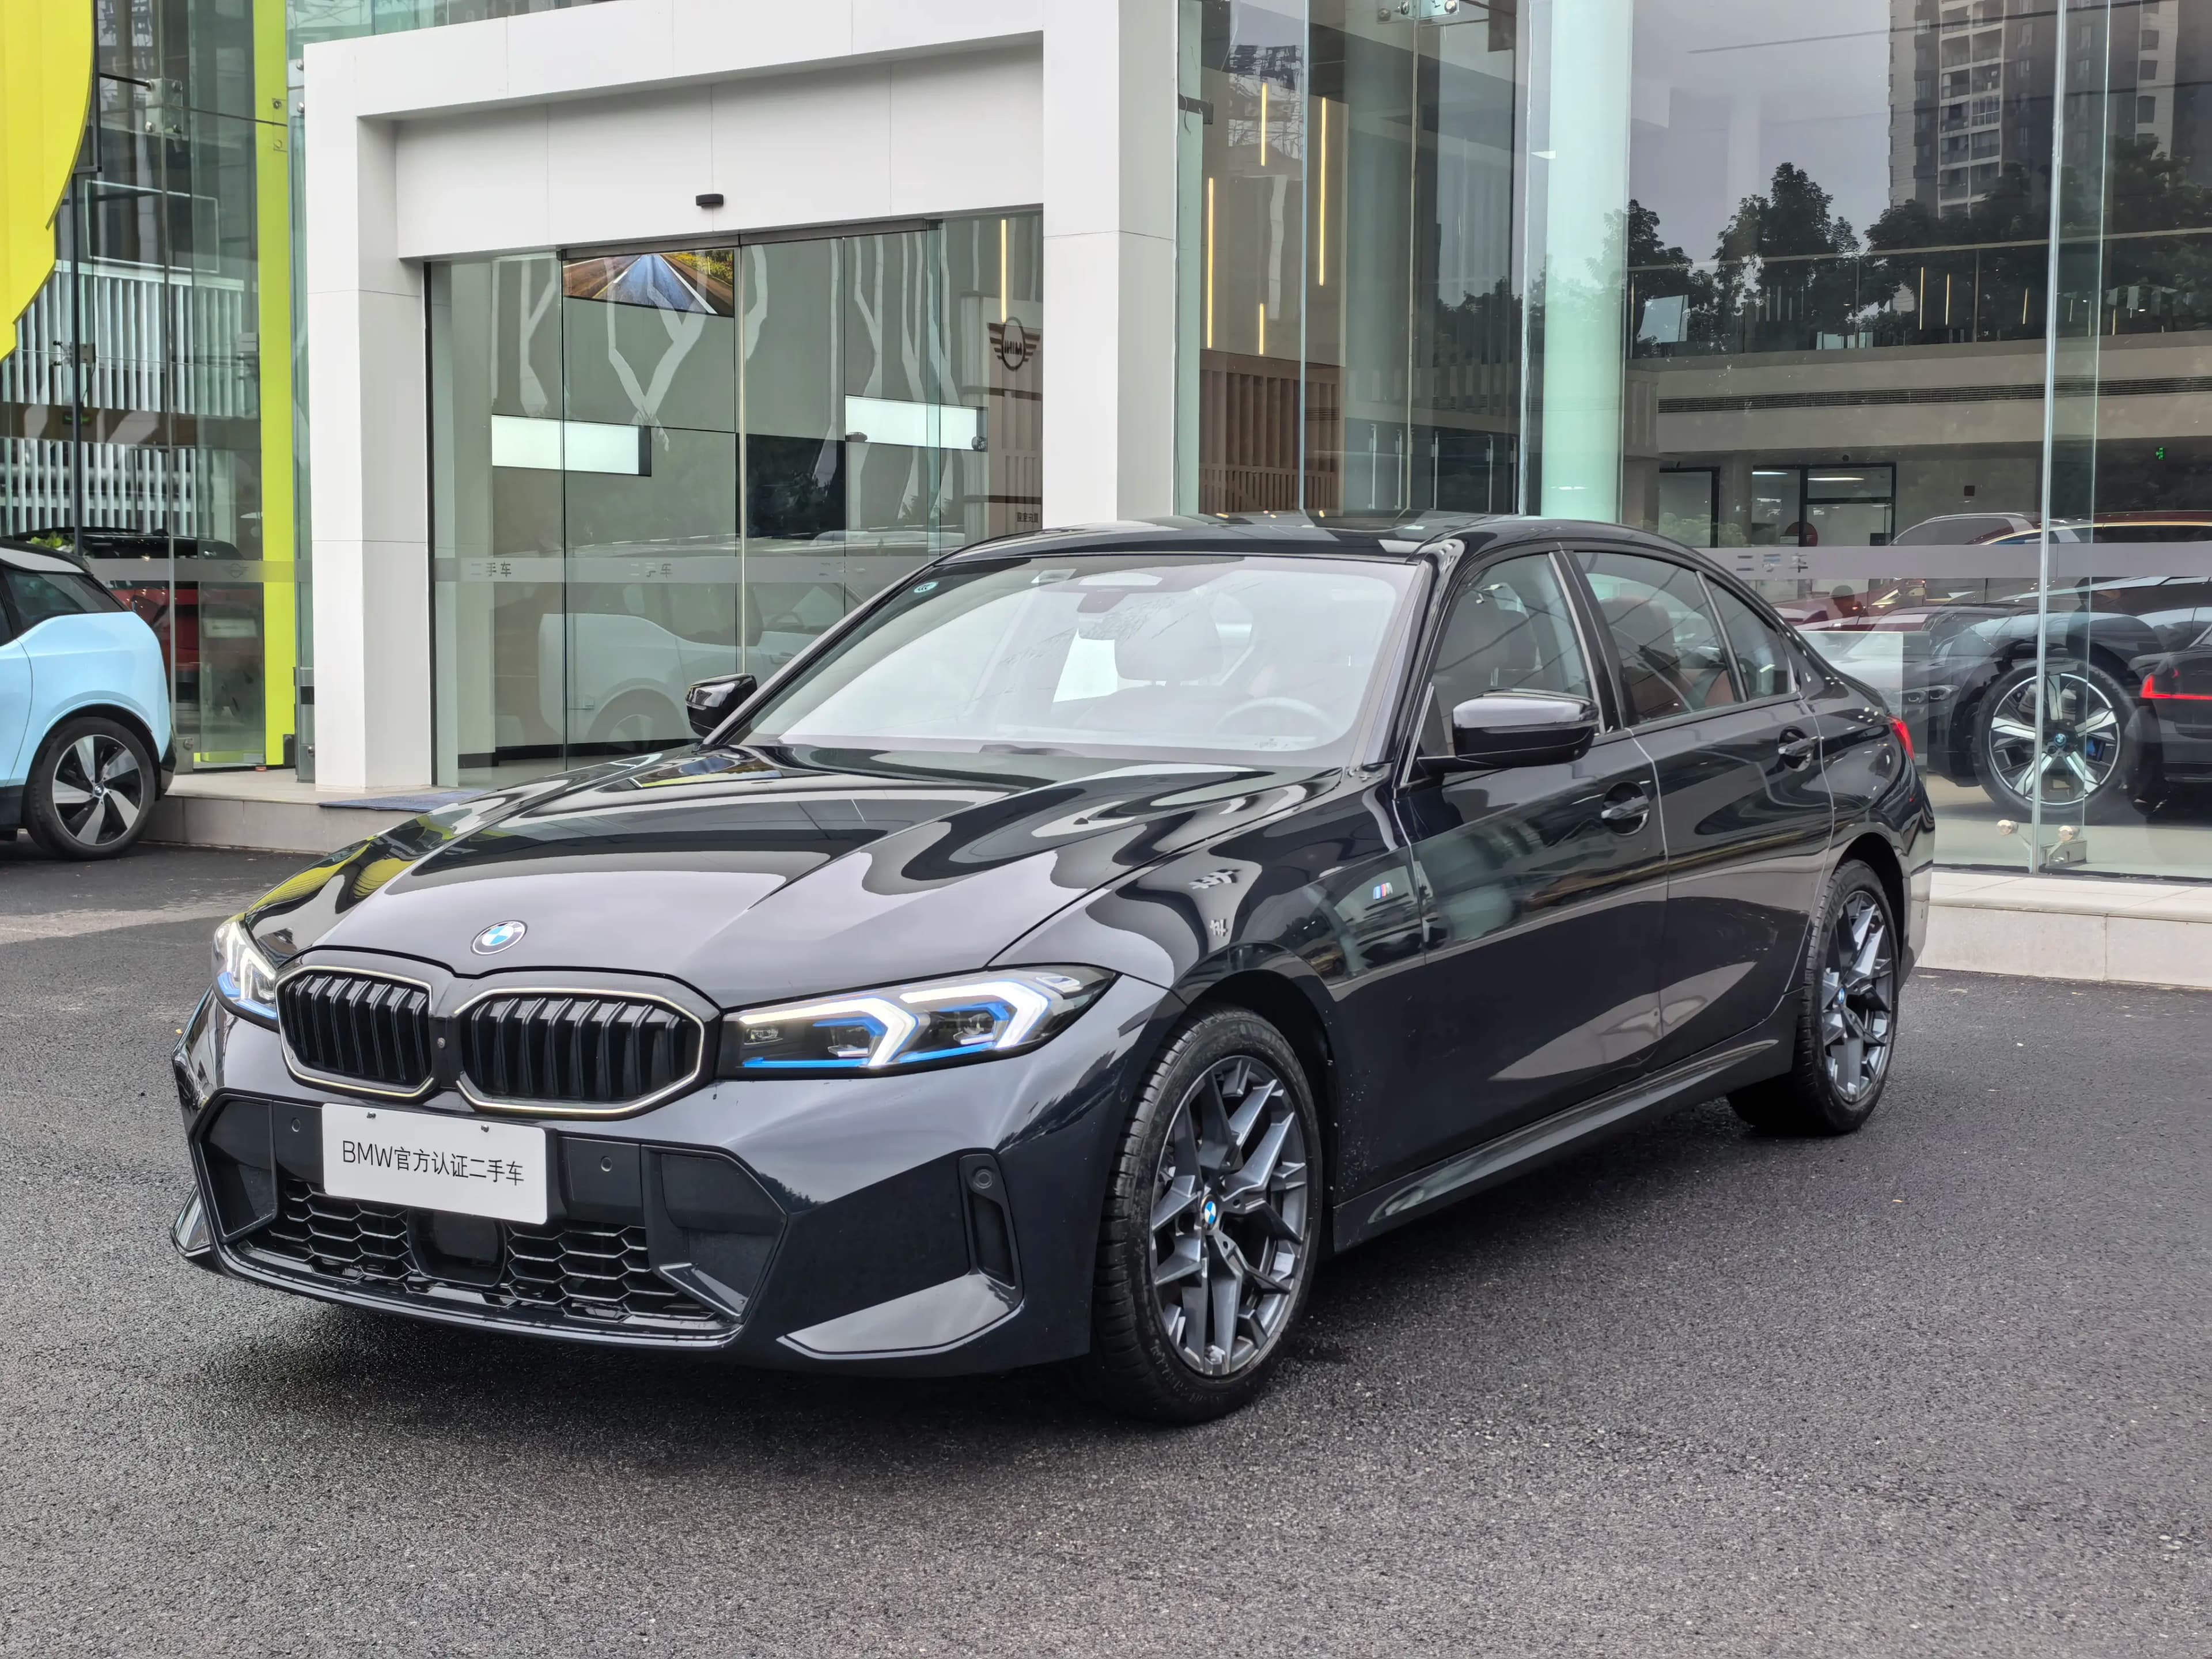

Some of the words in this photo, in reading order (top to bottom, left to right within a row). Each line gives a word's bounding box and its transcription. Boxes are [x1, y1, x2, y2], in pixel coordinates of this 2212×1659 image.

[471, 560, 512, 577] 二手车
[342, 1140, 524, 1186] BMW官方认证二手车
